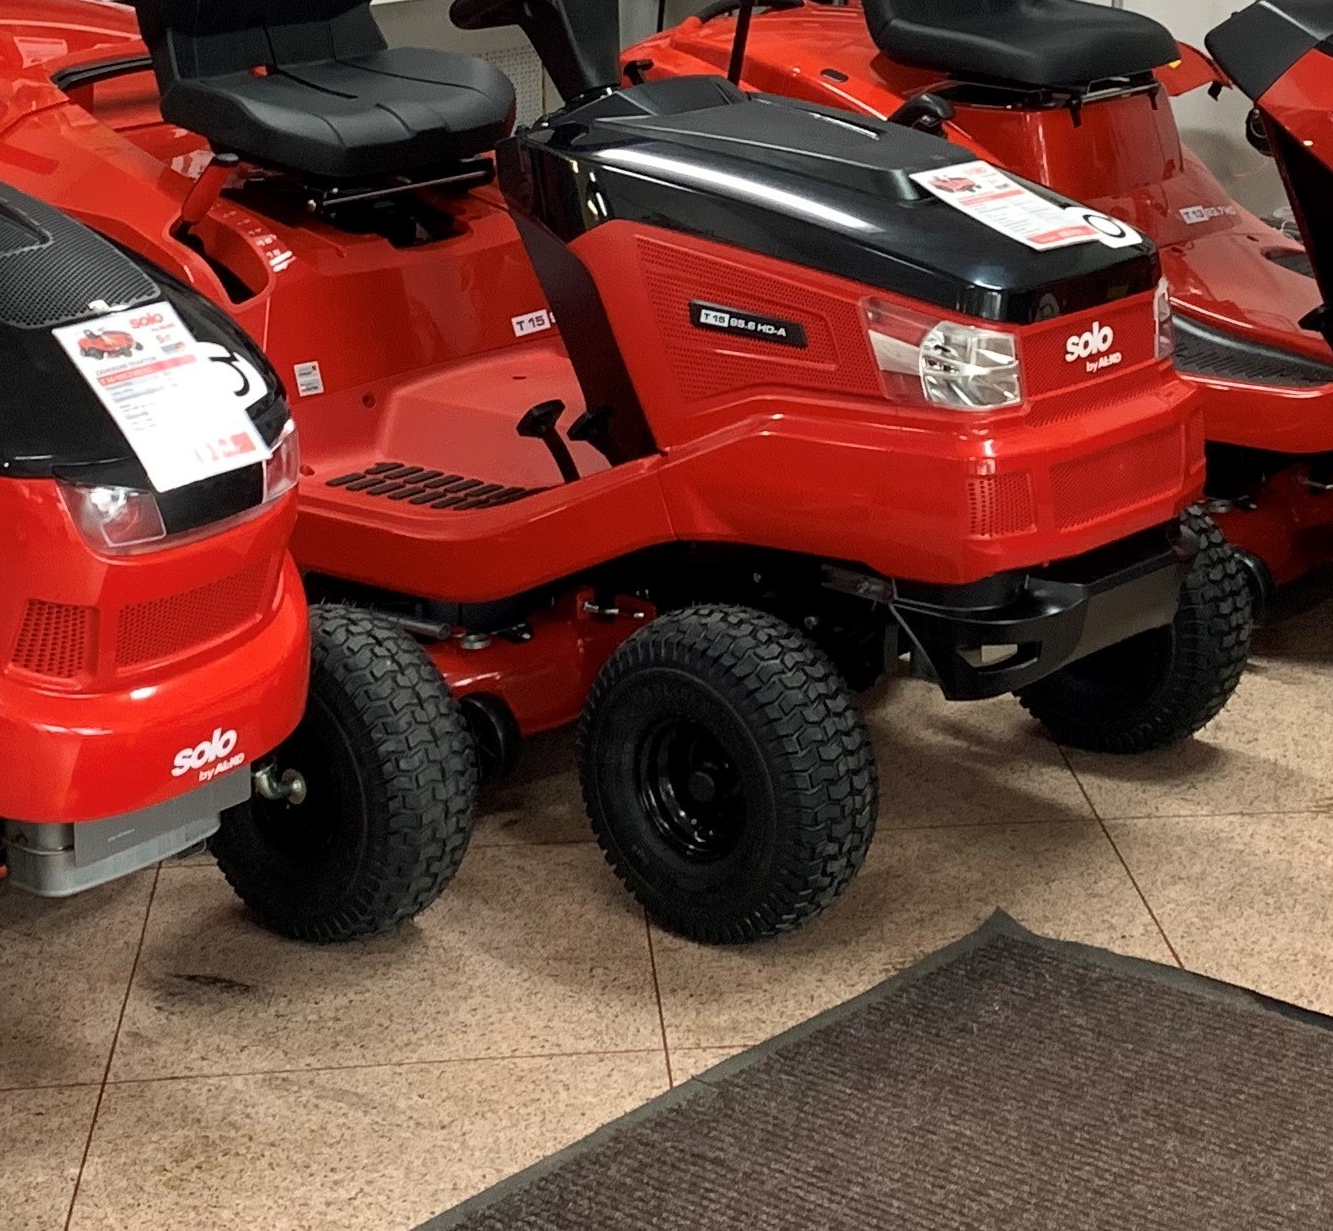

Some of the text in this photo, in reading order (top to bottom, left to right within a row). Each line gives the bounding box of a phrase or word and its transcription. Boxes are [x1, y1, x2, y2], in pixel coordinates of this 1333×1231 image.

[129, 312, 164, 329] solo
[516, 315, 545, 332] T 15
[756, 321, 787, 337] HD-A
[1064, 321, 1114, 363] solo
[1085, 361, 1099, 373] by
[170, 727, 238, 777] solo
[198, 769, 213, 782] by
